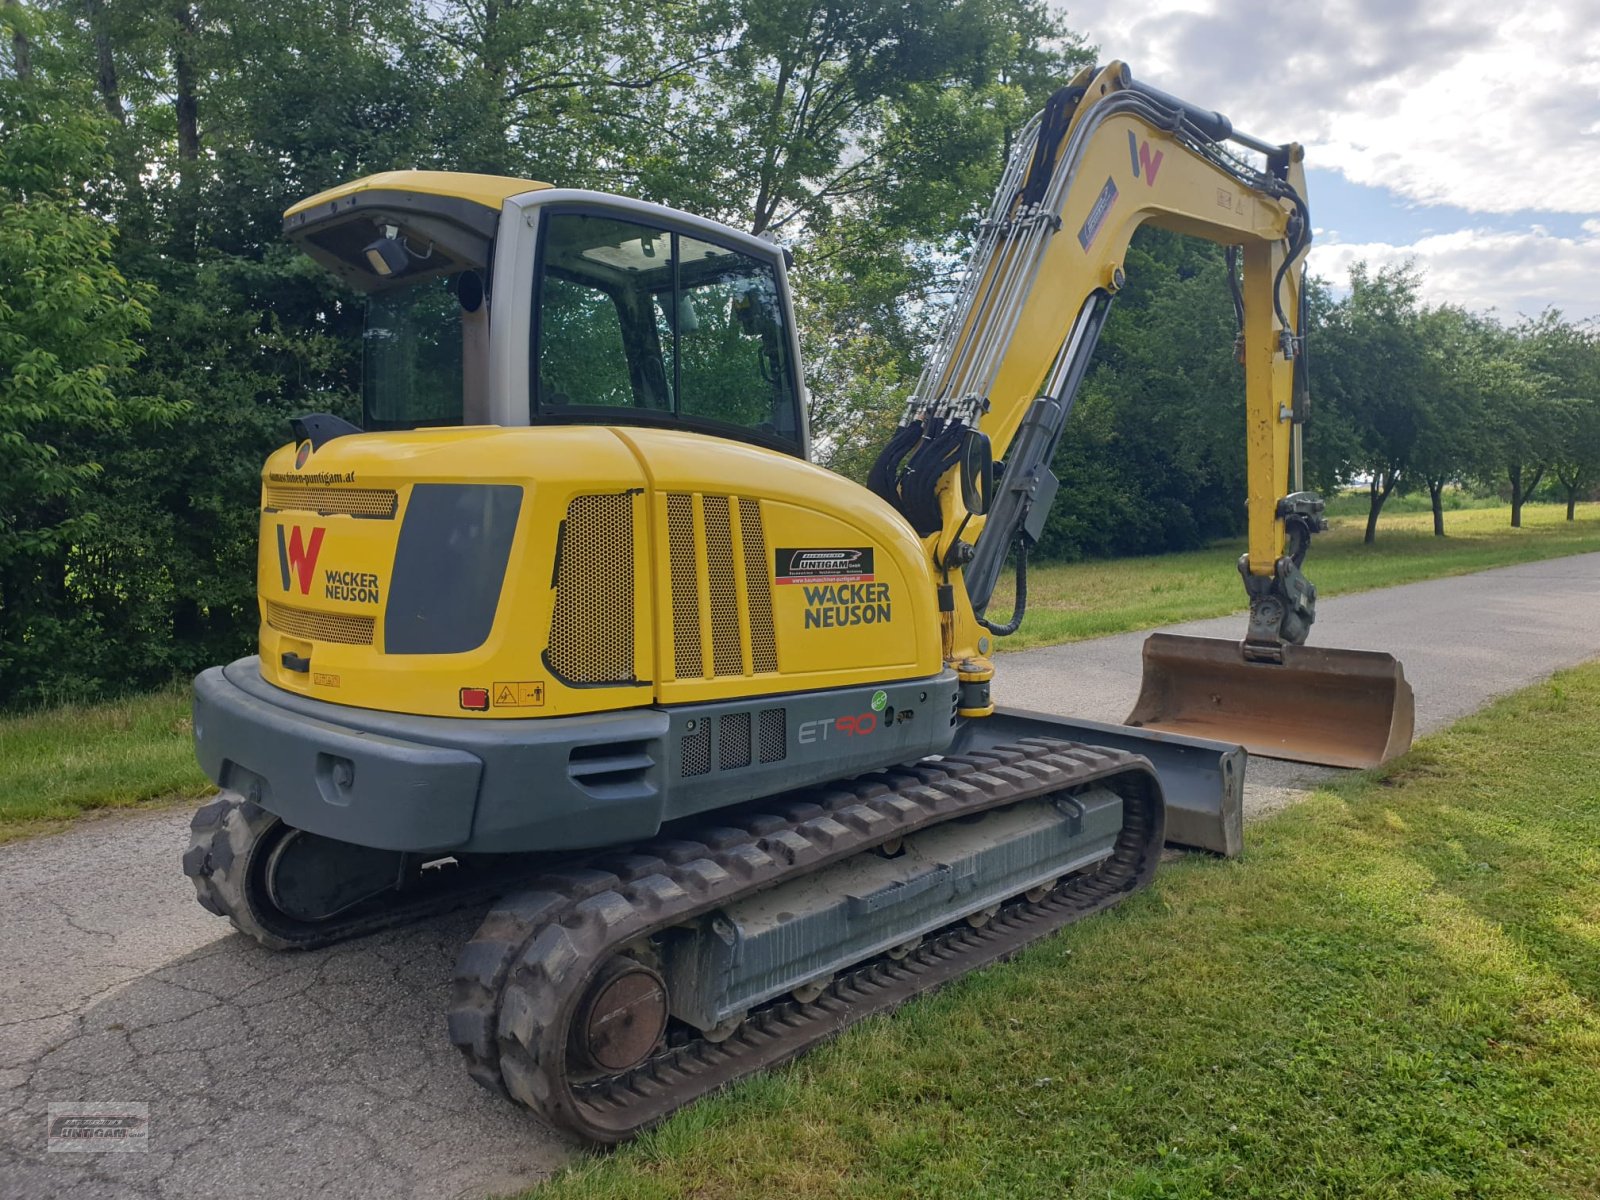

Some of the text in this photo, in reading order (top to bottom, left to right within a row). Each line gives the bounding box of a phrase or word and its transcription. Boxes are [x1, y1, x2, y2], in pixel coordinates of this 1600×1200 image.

[325, 570, 379, 589] WACKER
[325, 585, 379, 604] NEUSON
[803, 582, 891, 607] WACKER
[804, 603, 891, 629] NEUSON
